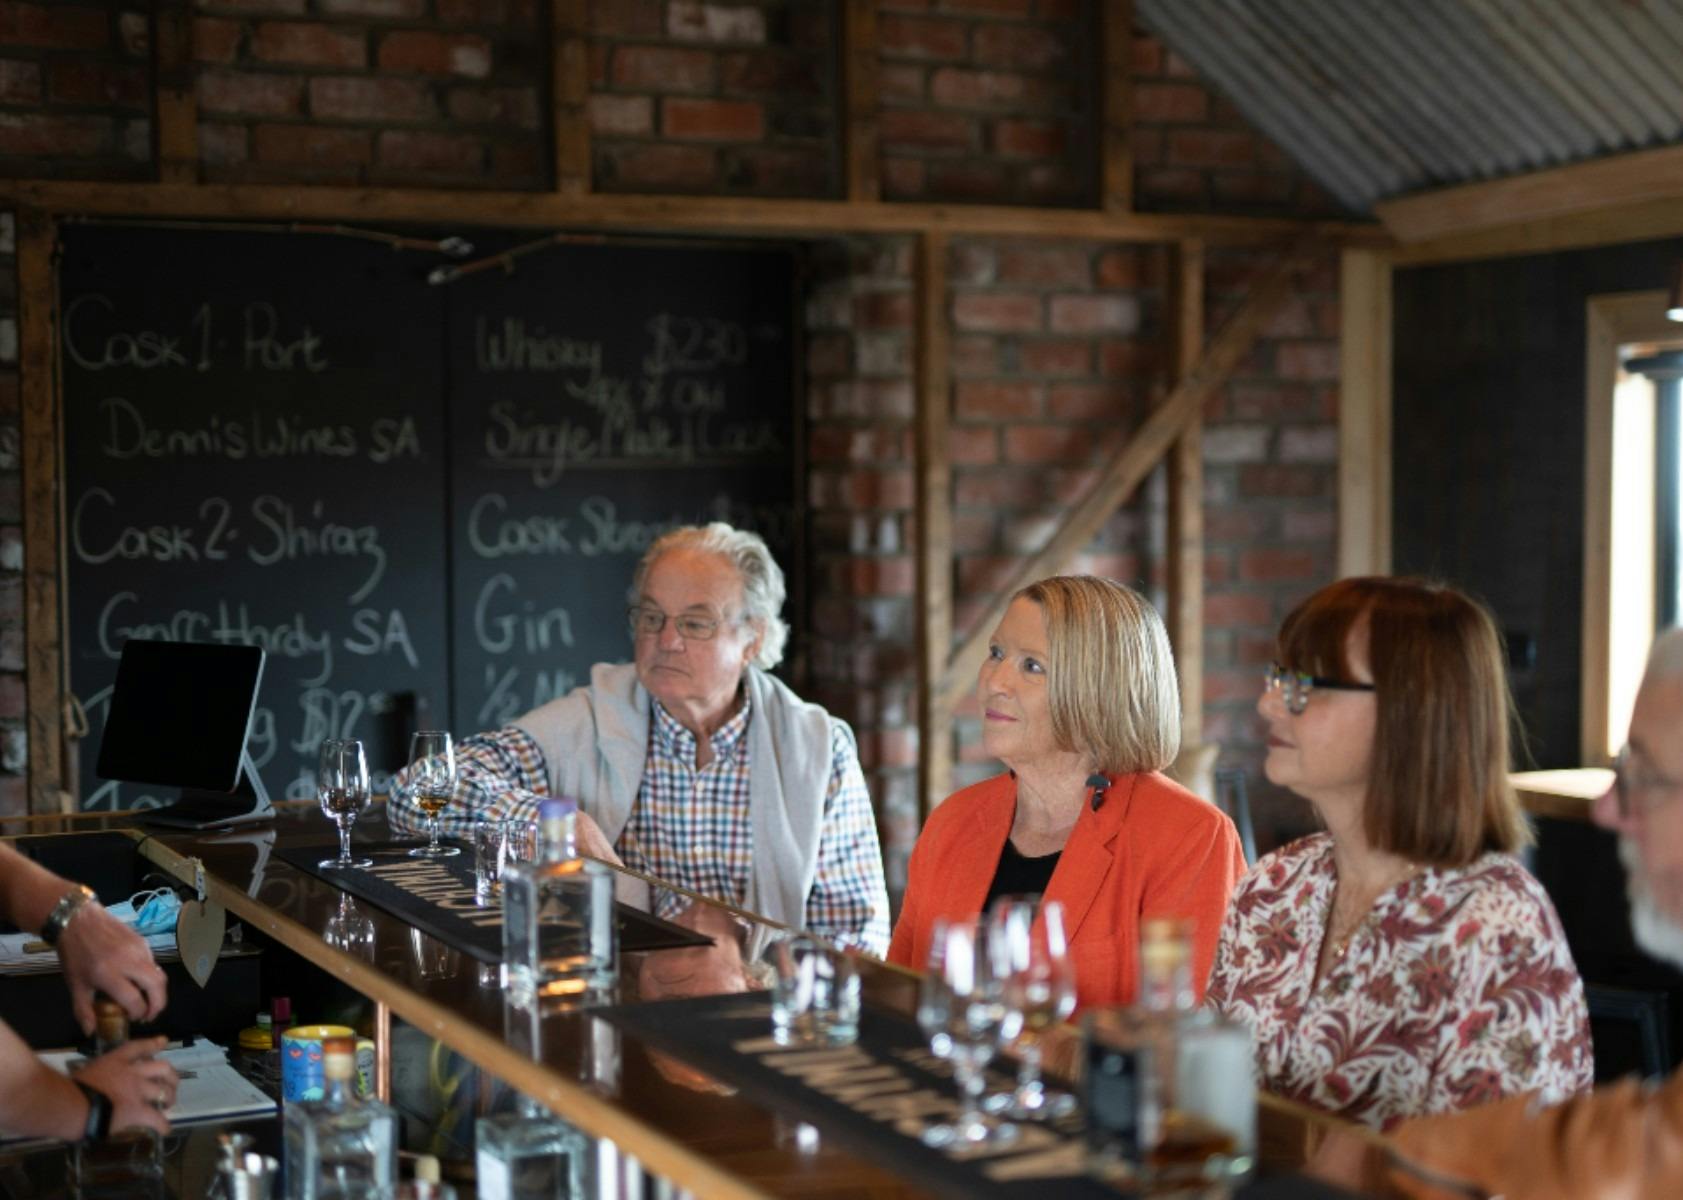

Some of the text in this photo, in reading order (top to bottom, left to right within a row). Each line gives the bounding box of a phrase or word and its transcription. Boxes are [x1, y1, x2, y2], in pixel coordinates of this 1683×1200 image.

[62, 292, 188, 372] Cask
[242, 301, 329, 373] Port
[98, 395, 422, 464] Dennis Wines SA
[484, 398, 600, 489] Single
[72, 486, 200, 565] Cask
[247, 493, 388, 605] Shiraz
[467, 492, 572, 559] Cask
[343, 608, 419, 669] SA
[474, 571, 577, 656] Gin
